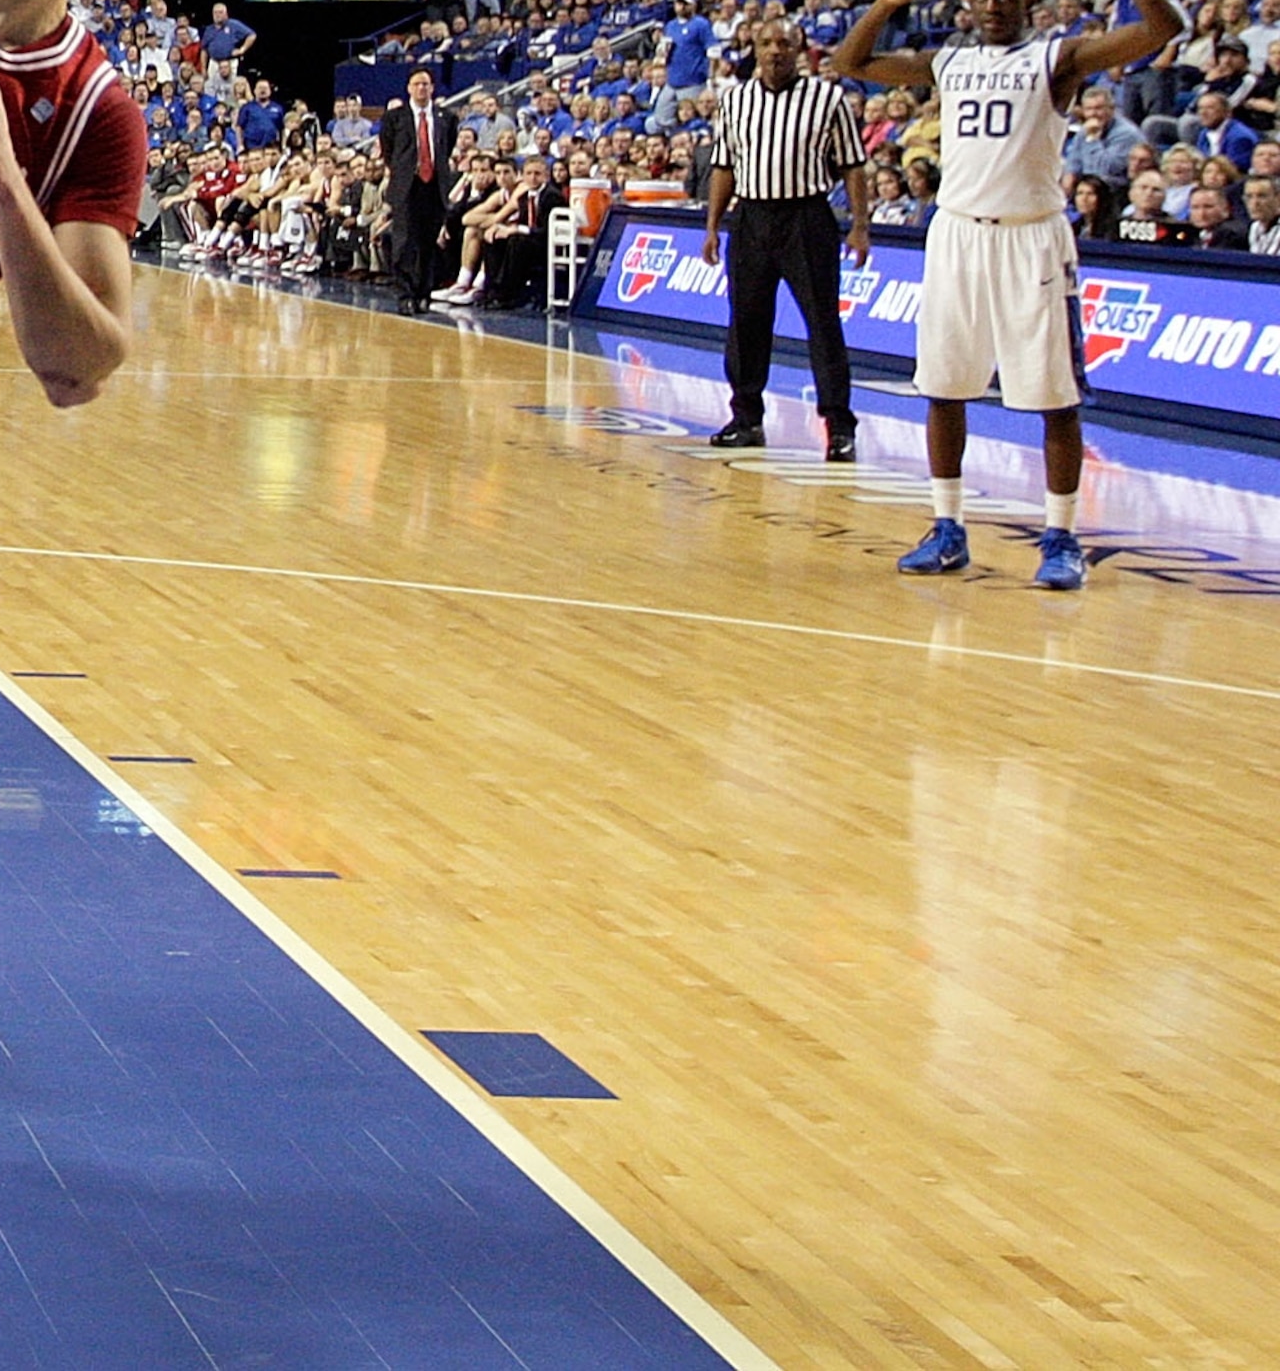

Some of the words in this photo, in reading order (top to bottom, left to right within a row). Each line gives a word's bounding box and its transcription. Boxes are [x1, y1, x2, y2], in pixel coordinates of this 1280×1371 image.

[945, 72, 1040, 91] KENTUCKY
[958, 99, 1014, 138] 20
[1148, 314, 1253, 369] AUTO
